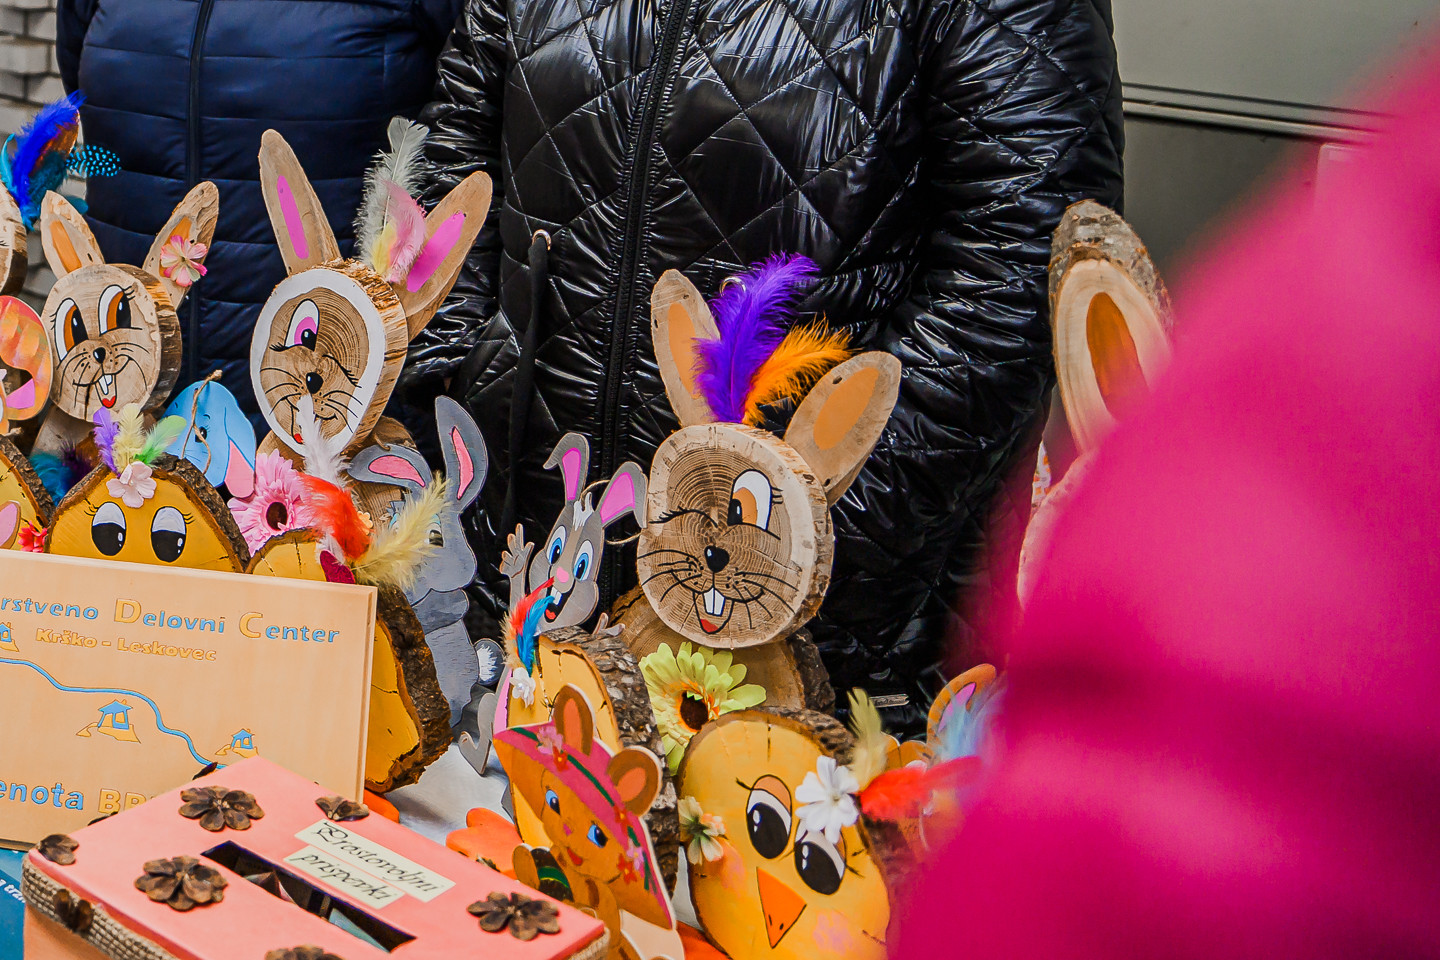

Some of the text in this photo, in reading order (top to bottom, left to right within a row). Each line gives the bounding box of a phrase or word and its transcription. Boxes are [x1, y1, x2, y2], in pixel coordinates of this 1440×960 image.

[113, 598, 226, 634] Delovni
[239, 611, 341, 644] Center
[35, 628, 98, 648] Krško
[117, 637, 218, 662] Leskovec
